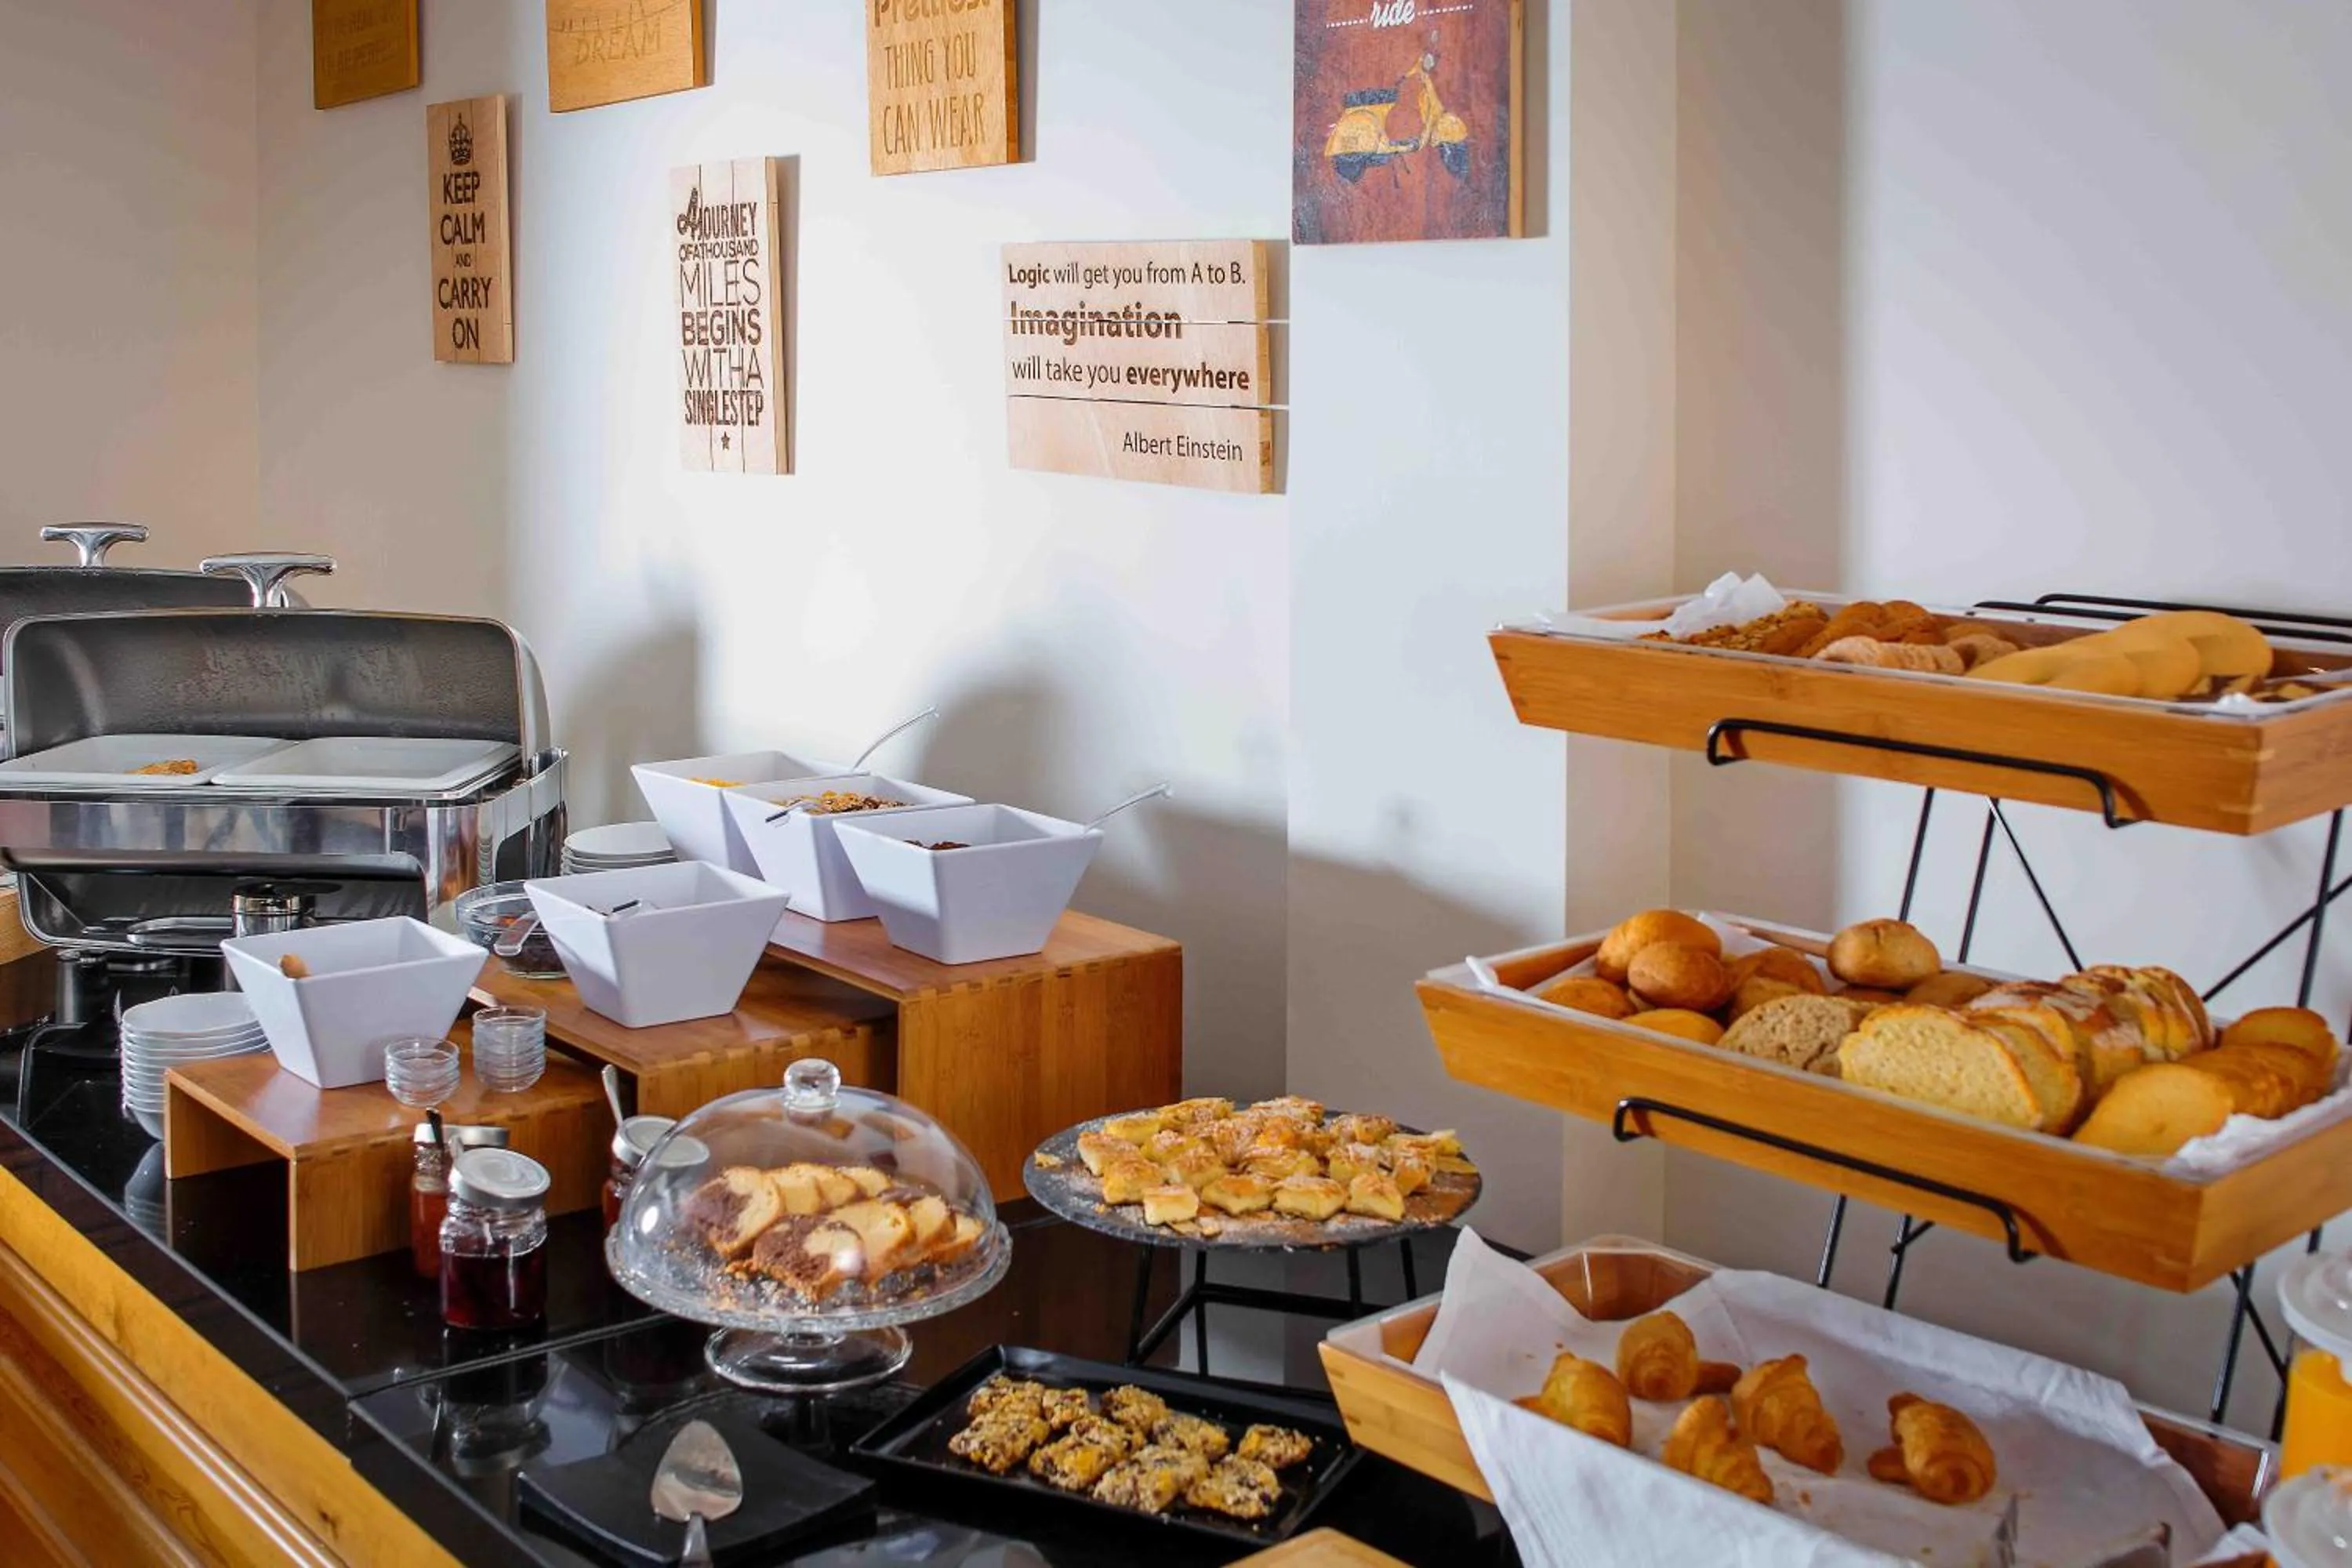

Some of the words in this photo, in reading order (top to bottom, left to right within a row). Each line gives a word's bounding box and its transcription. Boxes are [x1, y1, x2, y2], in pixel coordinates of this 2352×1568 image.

[575, 17, 661, 66] DREAM
[885, 39, 934, 89] THING
[942, 32, 976, 81] YOU
[884, 101, 920, 155] CAN
[928, 93, 986, 150] WEAR
[443, 172, 481, 205] KEEP
[440, 212, 485, 245] CALM
[697, 201, 757, 241] JOURNEY
[456, 253, 471, 267] AND
[1008, 263, 1050, 289] Logic
[1053, 262, 1080, 284] will
[1083, 264, 1109, 289] get
[1113, 269, 1142, 289] you
[1147, 262, 1186, 285] from
[1191, 263, 1203, 284] A
[1207, 264, 1225, 285] to
[1230, 262, 1246, 285] B.
[438, 277, 493, 310] CARRY
[680, 259, 761, 307] MILES
[452, 318, 480, 350] ON
[683, 309, 762, 347] BEGINS
[1011, 300, 1182, 346] Imagination
[1011, 355, 1040, 380] will
[1046, 357, 1083, 382] take
[1087, 366, 1120, 390] you
[1126, 361, 1250, 394] everywhere
[1123, 432, 1172, 456] Albert
[1177, 434, 1243, 462] Einstein
